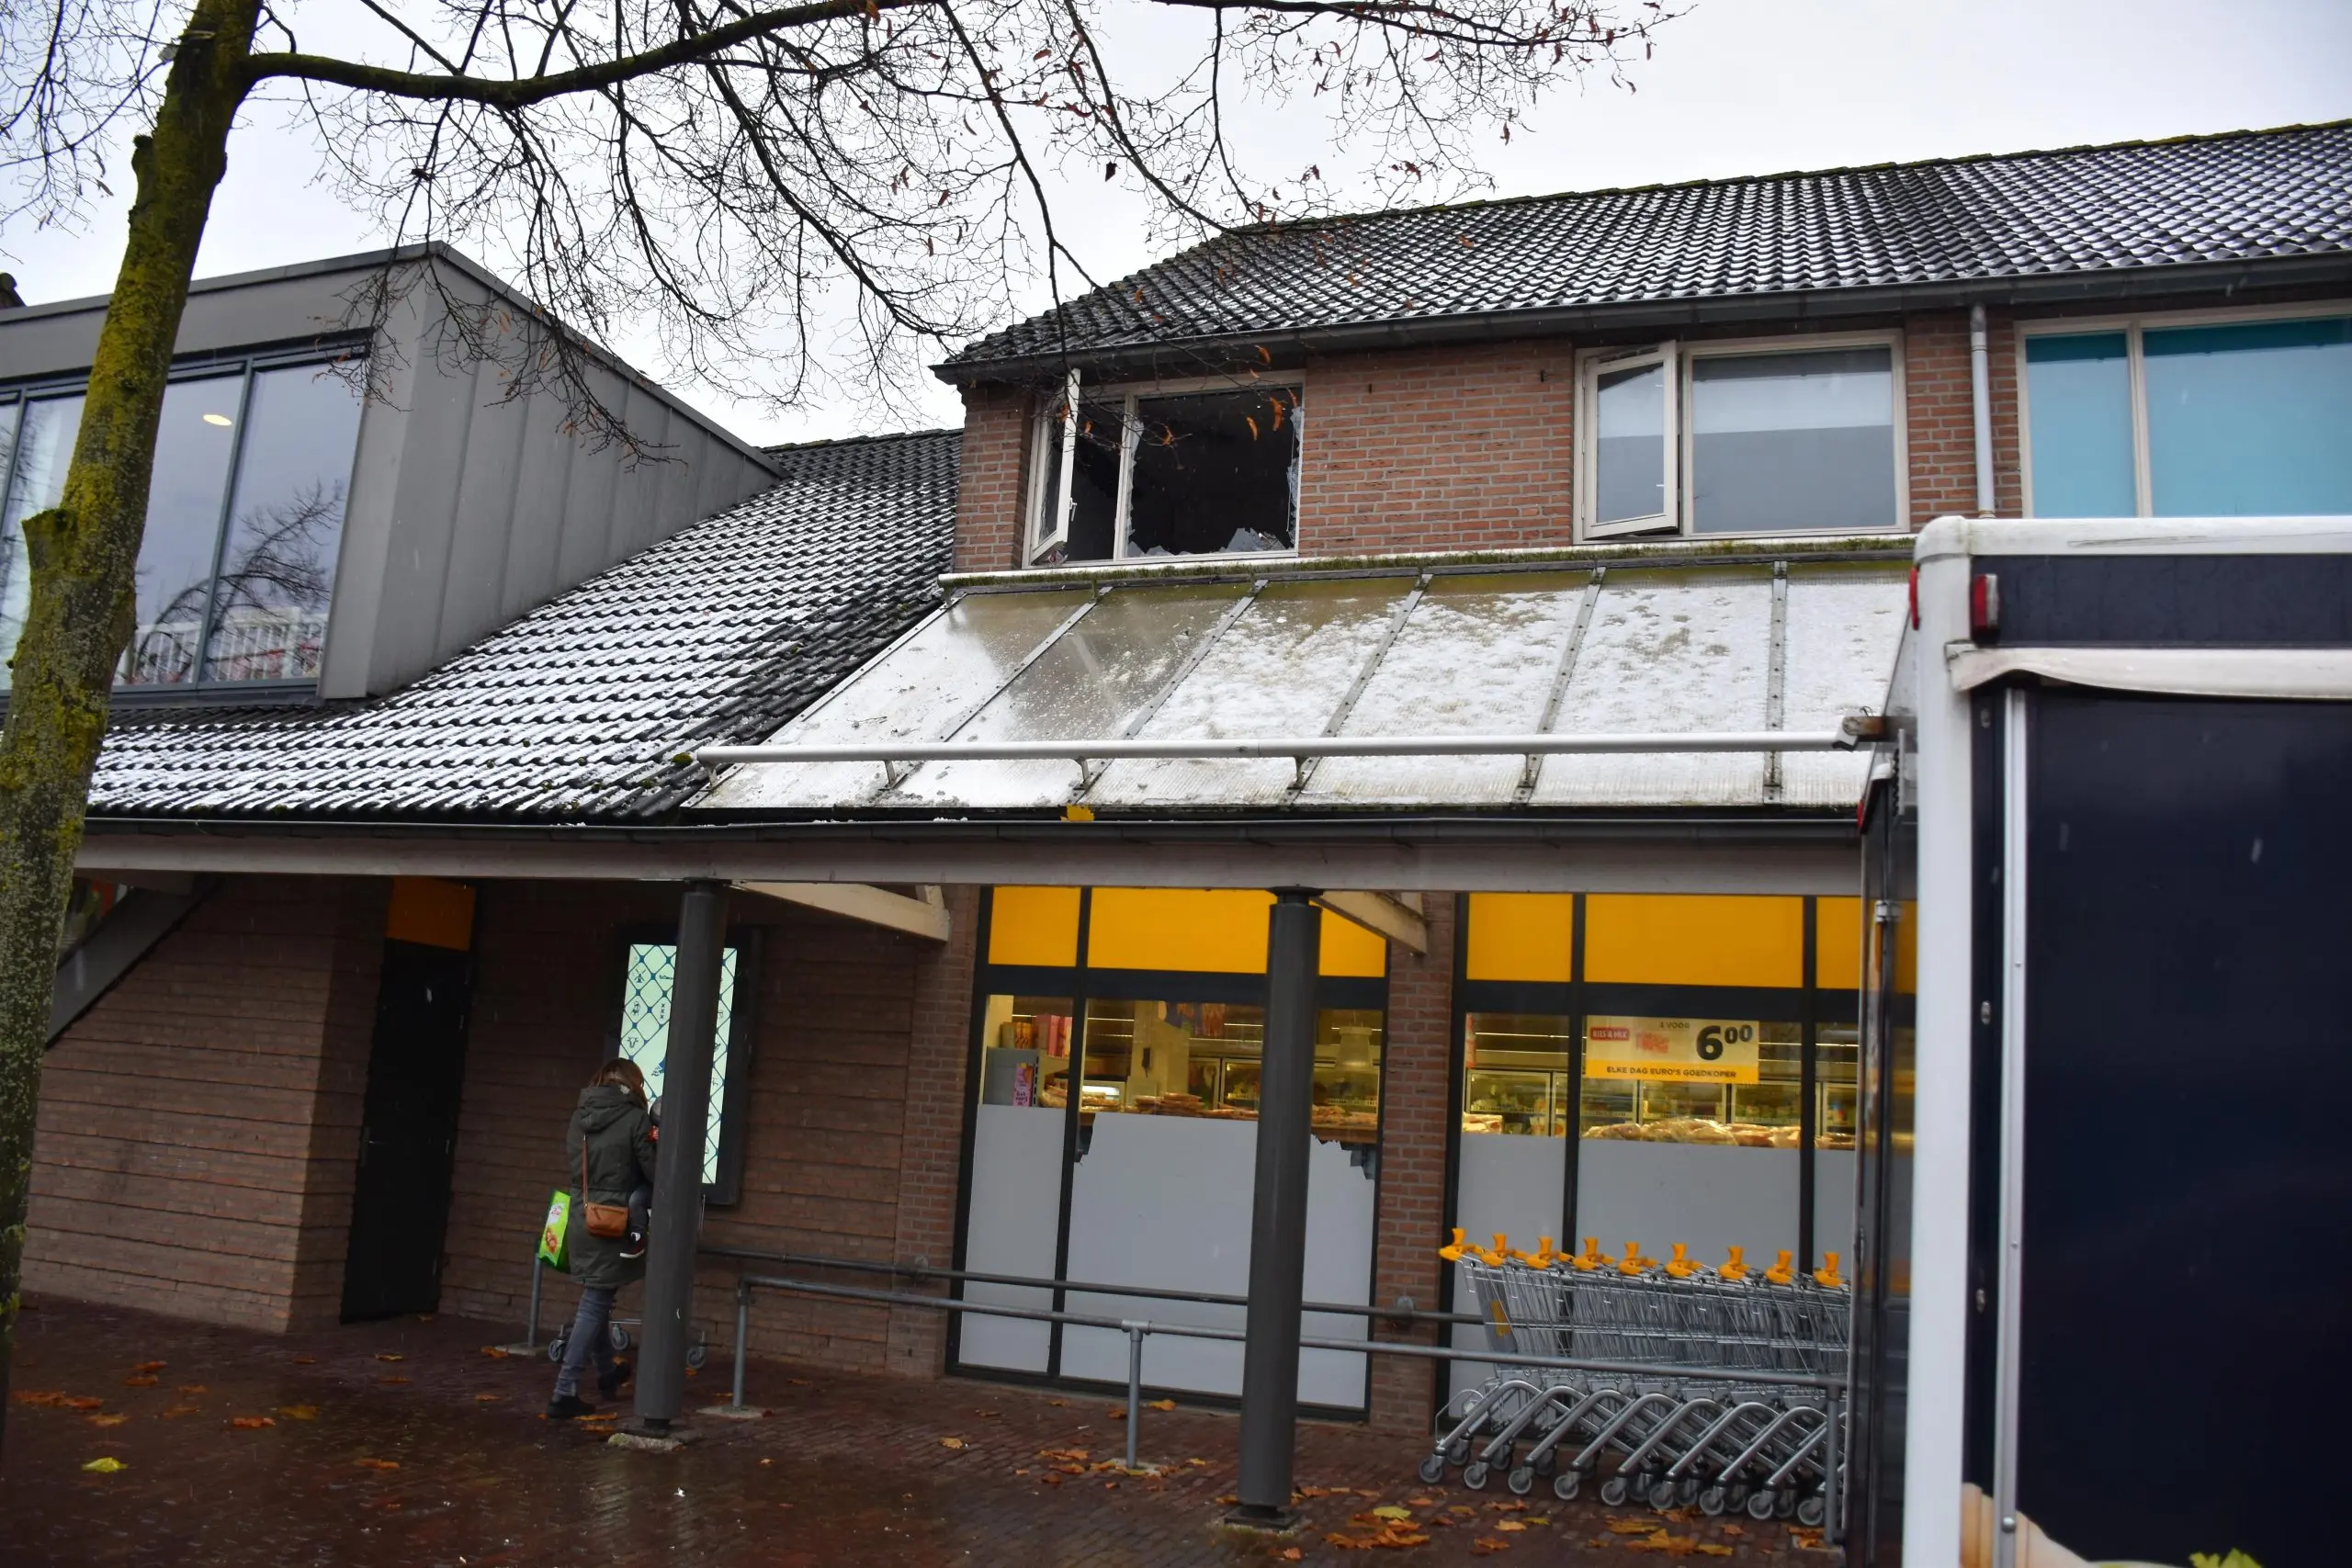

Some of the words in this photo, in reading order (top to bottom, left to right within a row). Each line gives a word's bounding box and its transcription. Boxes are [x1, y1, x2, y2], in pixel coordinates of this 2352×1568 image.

[1607, 1066, 1627, 1074] ELKE
[1630, 1066, 1648, 1075] DAG
[1650, 1067, 1680, 1076] EURO'S
[1683, 1069, 1736, 1077] GOEDKOPER
